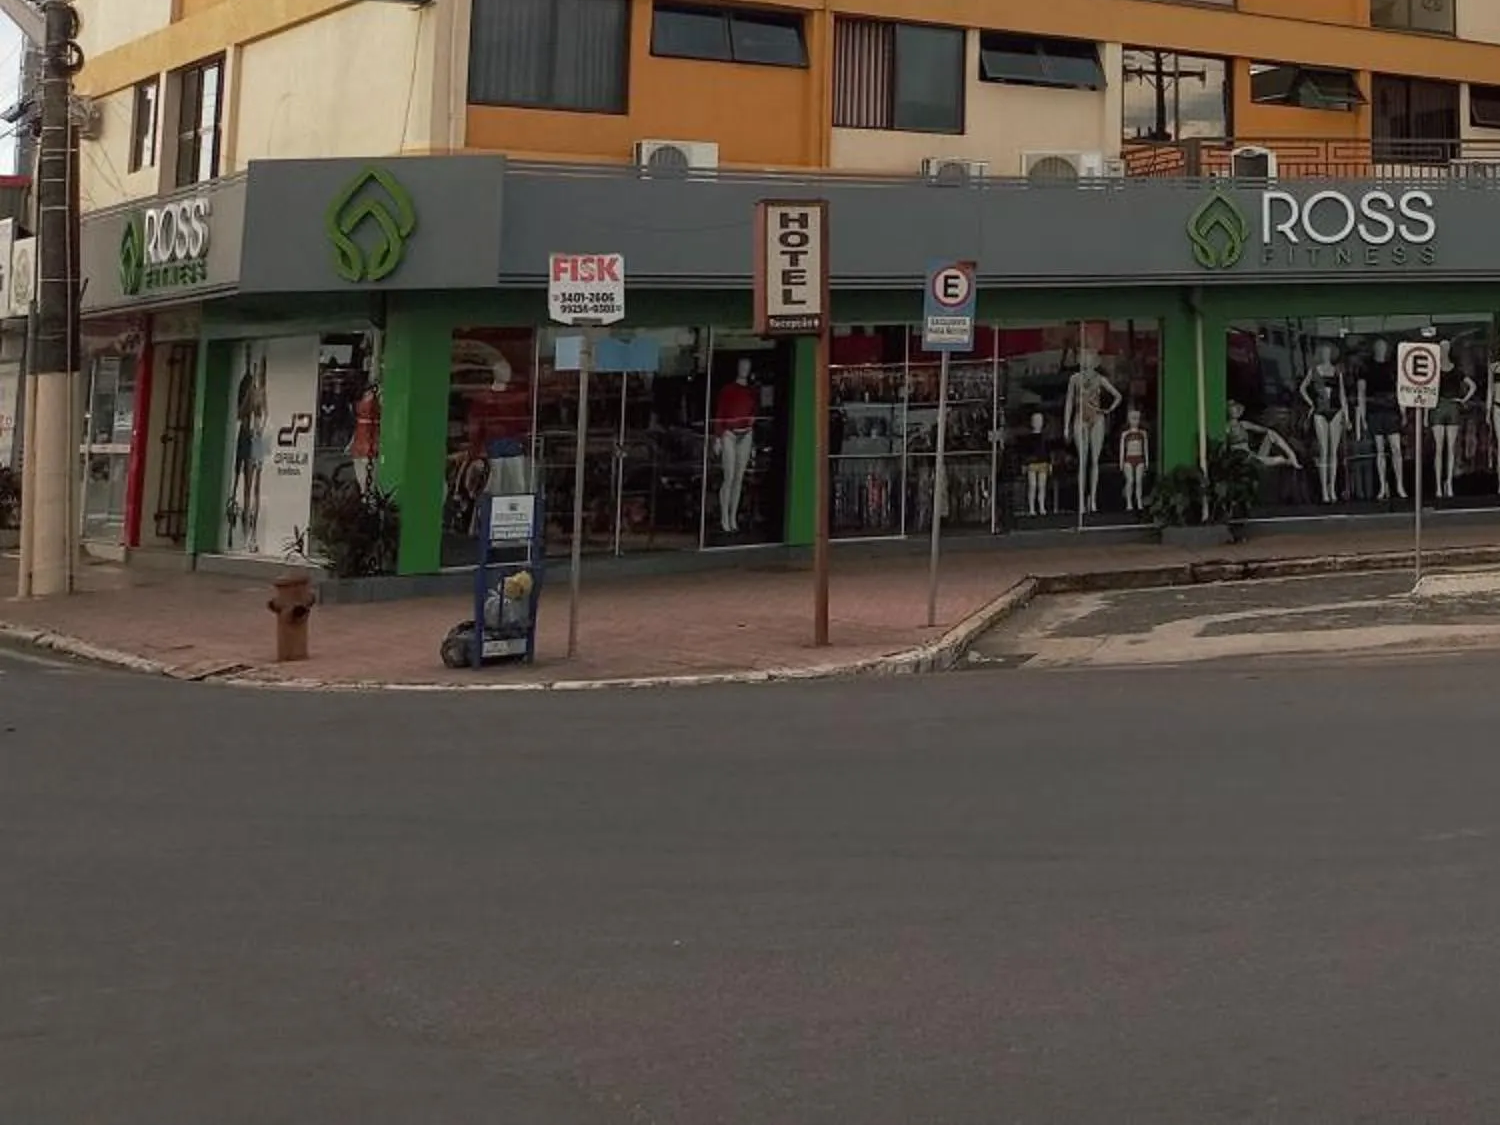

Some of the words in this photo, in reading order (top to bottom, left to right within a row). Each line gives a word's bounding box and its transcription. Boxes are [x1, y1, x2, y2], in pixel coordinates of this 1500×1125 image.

[143, 197, 210, 265] ROSS
[1262, 190, 1436, 245] ROSS
[552, 255, 620, 283] FISK
[779, 212, 809, 306] HOTEL
[1263, 246, 1437, 267] FITNESS
[943, 274, 960, 299] E
[1412, 354, 1429, 377] E
